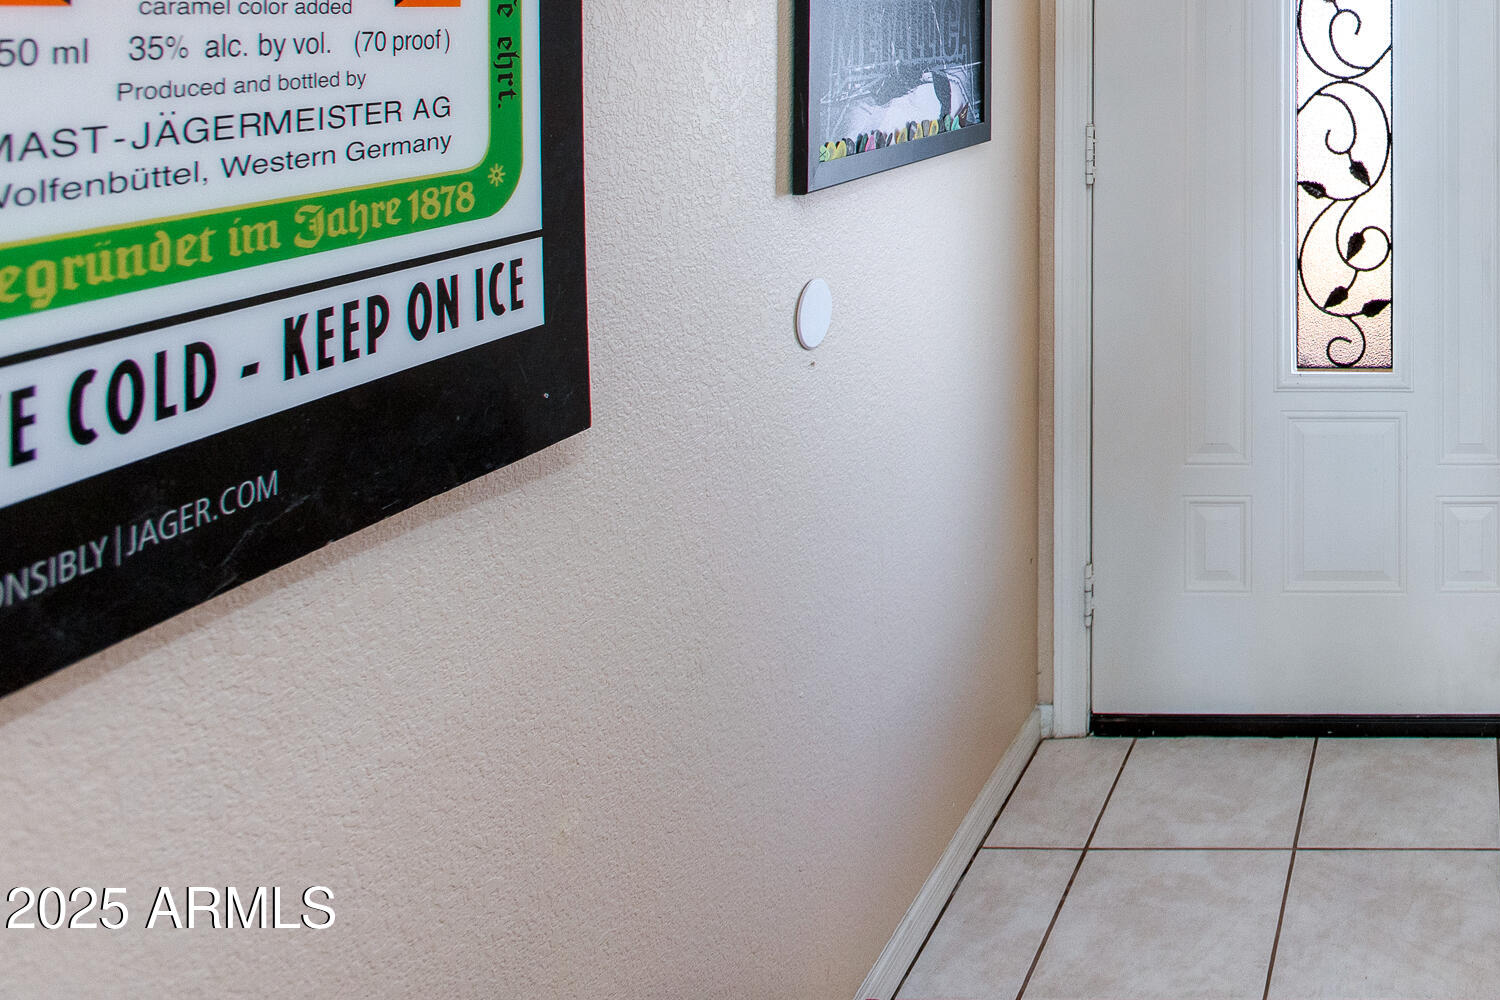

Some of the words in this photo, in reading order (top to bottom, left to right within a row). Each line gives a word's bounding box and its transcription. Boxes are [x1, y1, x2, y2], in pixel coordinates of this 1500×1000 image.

[52, 37, 89, 65] ml
[127, 33, 191, 63] 35%
[204, 30, 249, 59] alc.
[258, 31, 288, 62] by
[292, 29, 333, 56] vol.
[353, 29, 388, 59] (70
[392, 27, 452, 57] proof)
[116, 74, 228, 102] Produced
[232, 73, 273, 96] and
[277, 70, 341, 94] bottled
[345, 69, 368, 92] by
[493, 36, 520, 109] ehrt.
[412, 94, 453, 121] AG
[221, 146, 338, 180] Western
[346, 132, 453, 167] Germany
[0, 225, 217, 310] egründet
[229, 217, 282, 257] im
[293, 196, 403, 250] Jahre
[407, 181, 477, 226] 1878
[8, 386, 38, 468] E
[68, 341, 218, 446] COLD
[282, 293, 391, 382] KEEP
[406, 273, 460, 343] ON
[474, 257, 525, 322] ICE
[0, 535, 109, 609] NSIBLY
[126, 469, 279, 557] JAGER.COM
